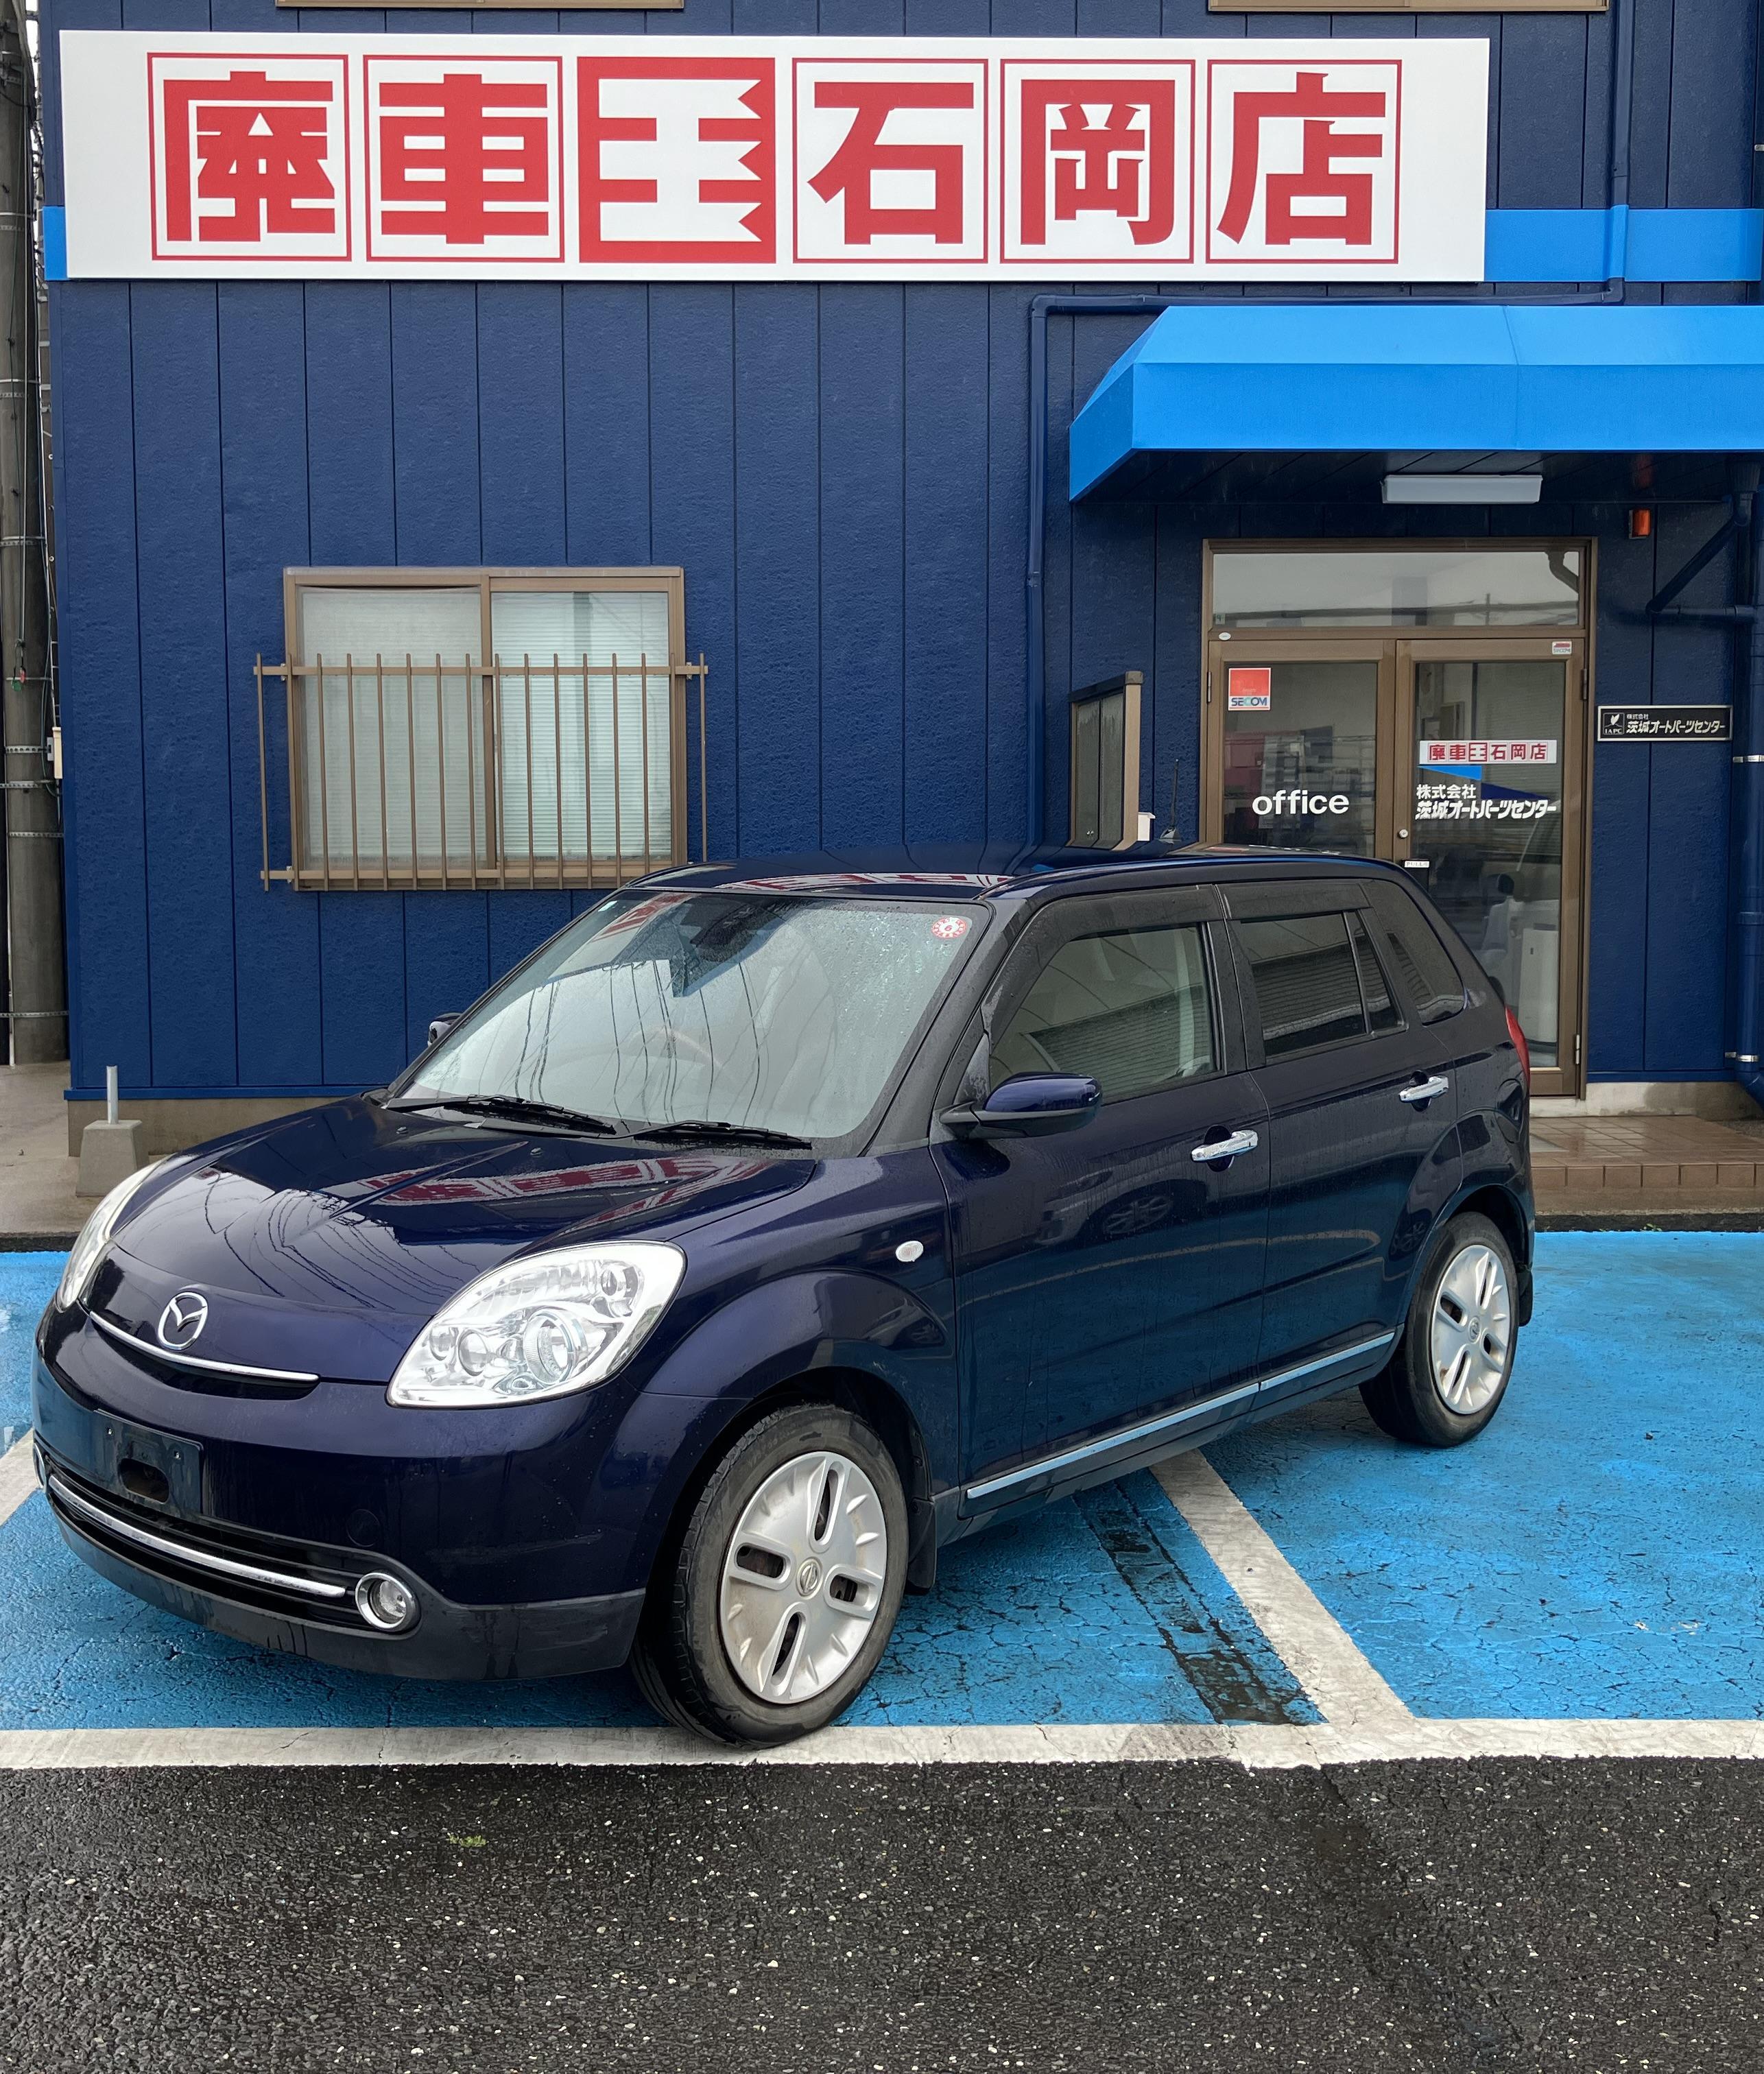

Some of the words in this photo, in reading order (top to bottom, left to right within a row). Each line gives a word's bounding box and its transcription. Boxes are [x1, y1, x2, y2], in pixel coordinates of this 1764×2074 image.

[163, 71, 1385, 246] 廃車王石岡店
[1231, 697, 1267, 706] SECOM
[1626, 720, 1726, 734] 茨城オートパーツセンター
[1416, 784, 1477, 799] 株式会社
[1252, 789, 1349, 815] office
[1415, 800, 1557, 820] 茨城オートパーツセンター
